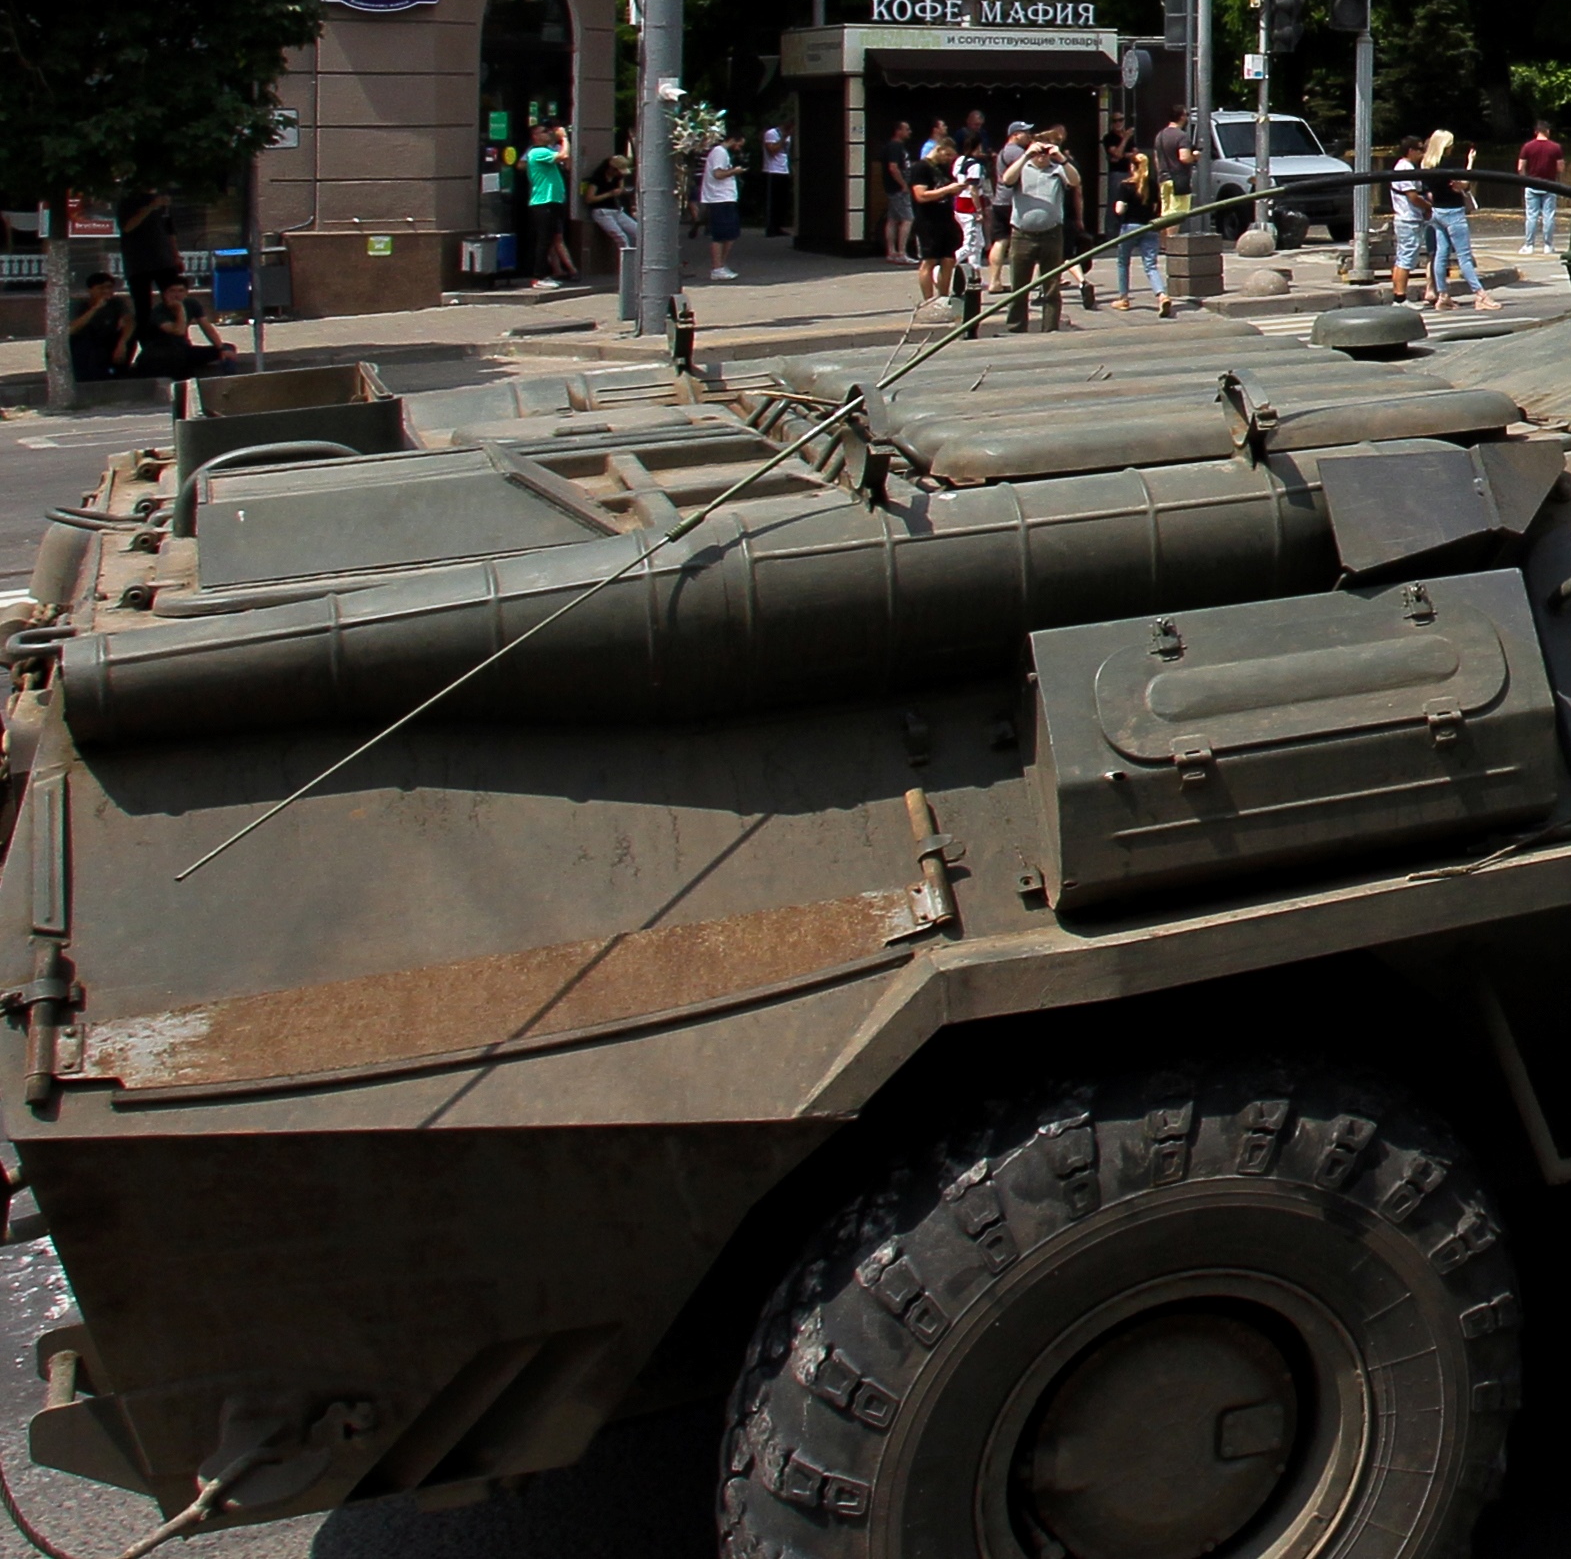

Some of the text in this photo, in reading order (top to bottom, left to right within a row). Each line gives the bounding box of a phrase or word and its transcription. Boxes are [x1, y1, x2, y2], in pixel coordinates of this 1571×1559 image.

[979, 0, 1096, 26] МАФИЯ
[947, 36, 956, 45] и
[958, 35, 1056, 47] сопутствующие
